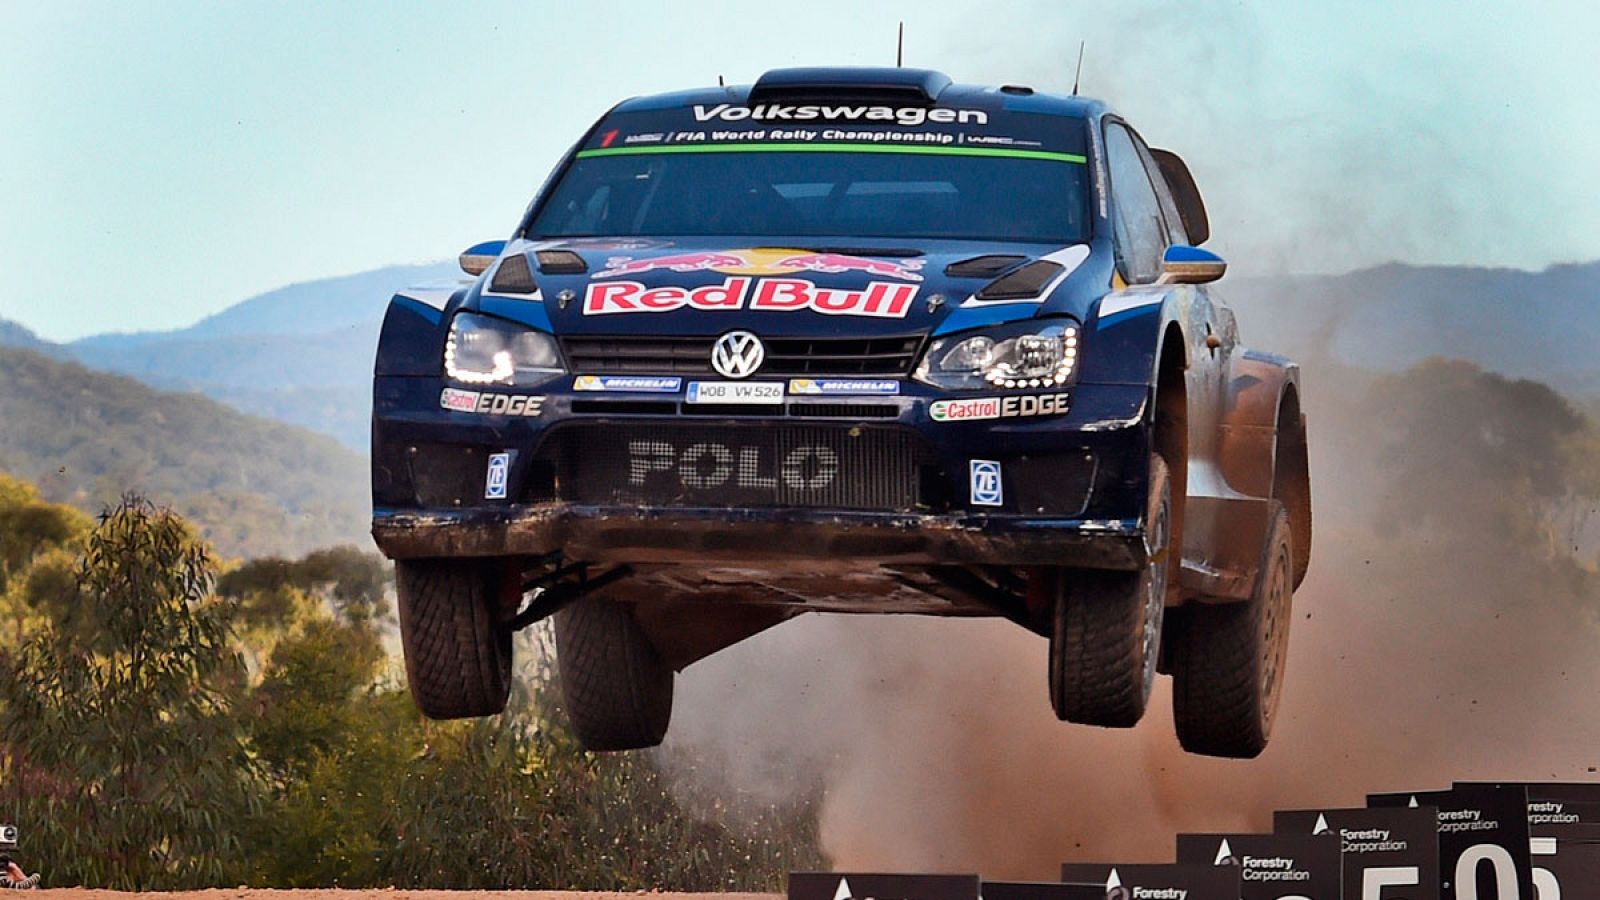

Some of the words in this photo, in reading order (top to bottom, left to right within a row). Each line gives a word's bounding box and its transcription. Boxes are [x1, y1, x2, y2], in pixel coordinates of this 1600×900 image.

[693, 103, 988, 125] Volkswagen
[602, 129, 619, 148] 1
[676, 131, 705, 141] FIA
[712, 130, 765, 140] World
[770, 130, 816, 141] Rally
[822, 130, 954, 143] Championship
[588, 278, 748, 312] Red
[755, 279, 914, 314] Bull
[605, 379, 678, 389] MICHELIN
[822, 382, 896, 390] MICHELIN
[700, 386, 726, 397] WOB
[735, 386, 753, 397] VW
[754, 386, 781, 397] 526
[477, 393, 546, 416] EDGE
[947, 401, 997, 418] Castrol
[1001, 393, 1069, 416] EDGE
[628, 441, 839, 491] POLO
[1436, 808, 1481, 821] orestry
[1528, 802, 1564, 814] restry
[1243, 855, 1294, 870] Forestry
[1242, 868, 1310, 882] Corporation
[1132, 886, 1188, 900] Forestry
